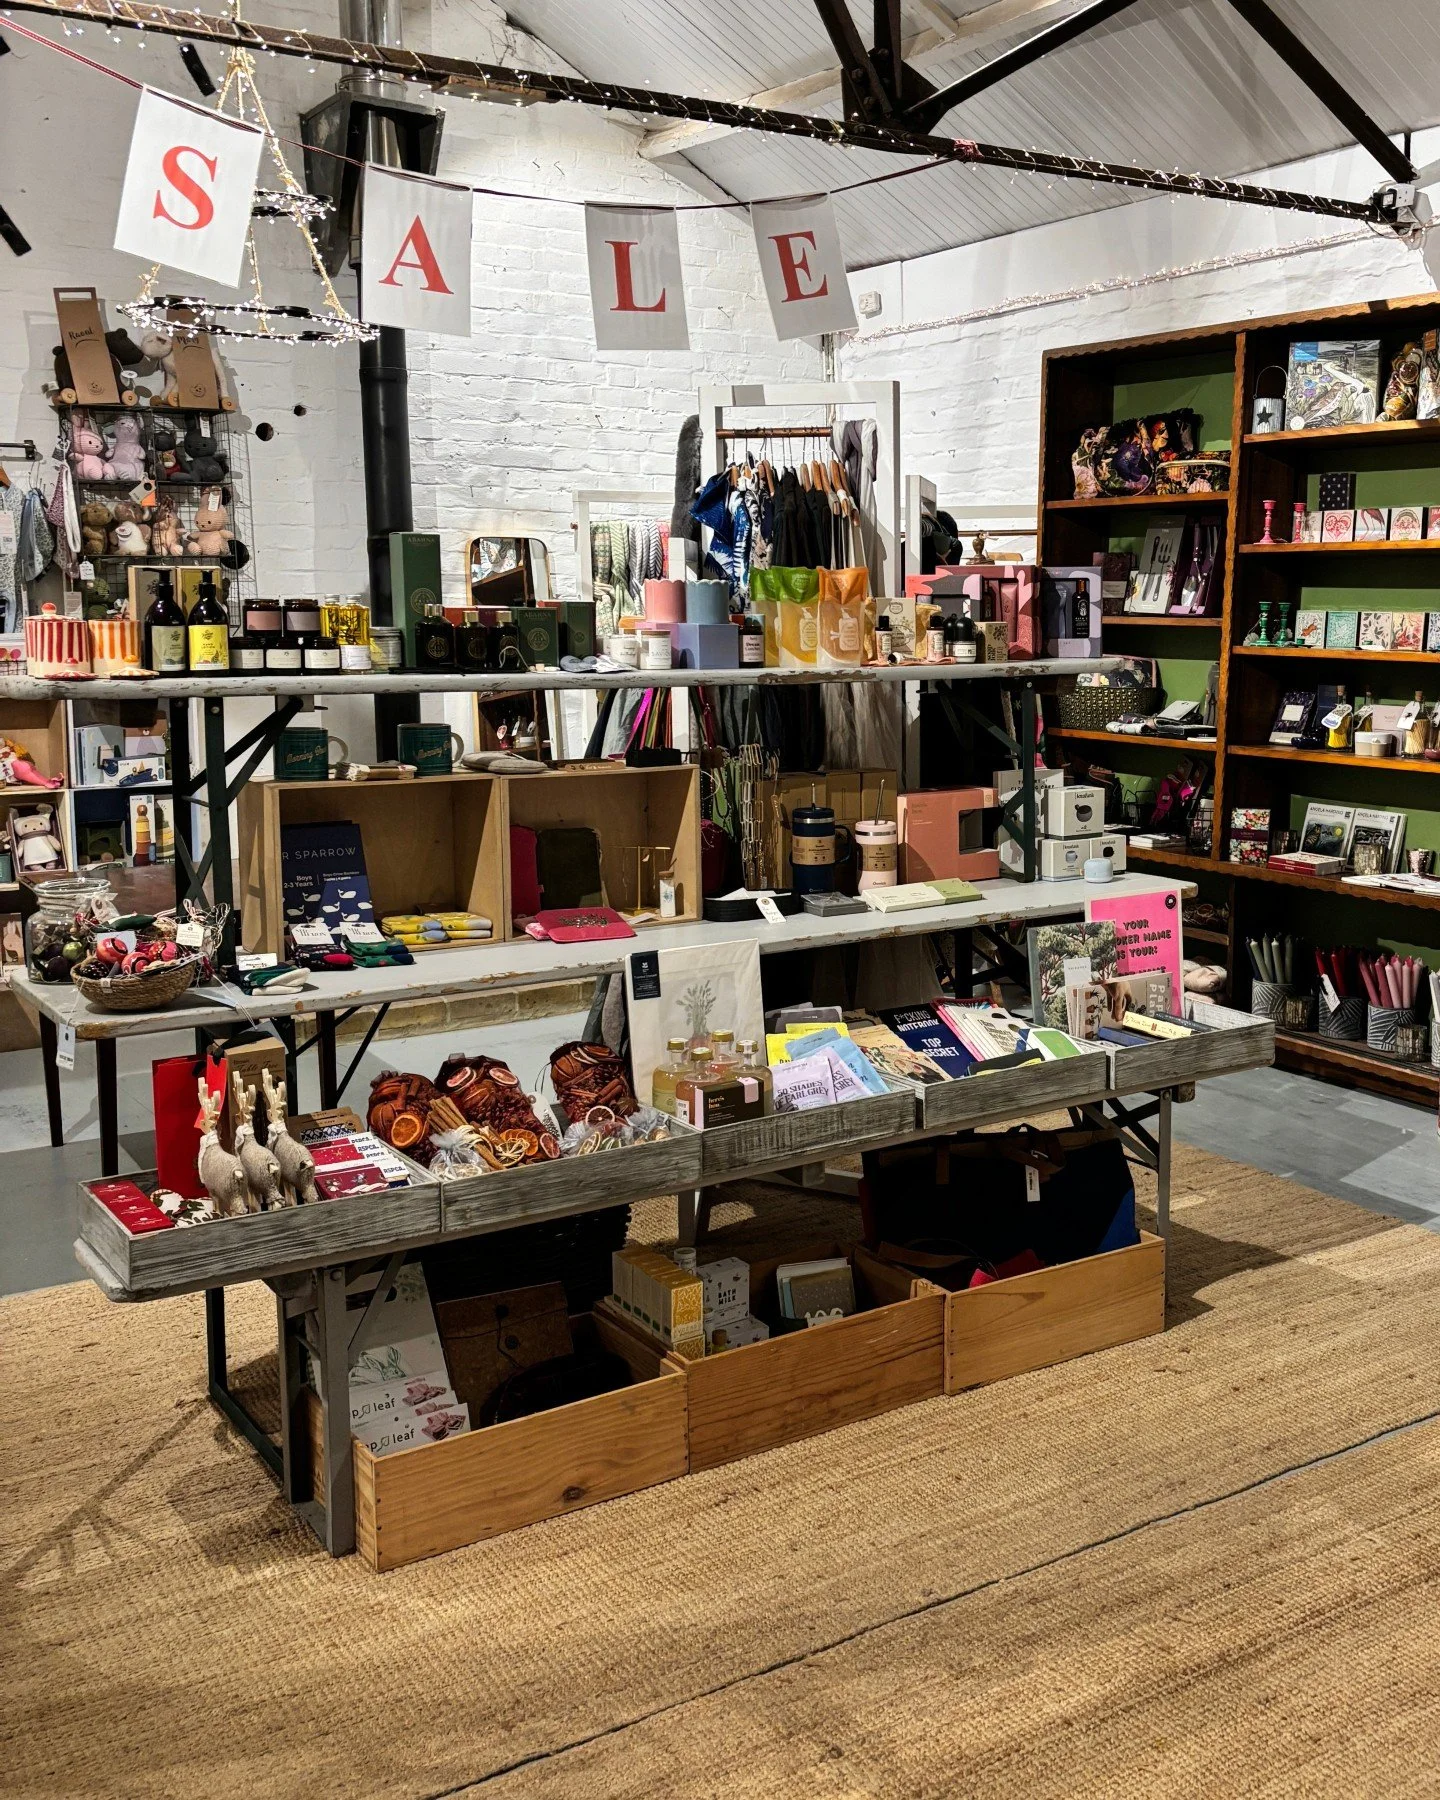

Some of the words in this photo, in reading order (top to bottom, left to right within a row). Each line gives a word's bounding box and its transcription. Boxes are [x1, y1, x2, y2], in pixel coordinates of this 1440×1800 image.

[294, 847, 356, 860] SPARROW
[295, 880, 314, 888] Years
[1123, 919, 1149, 931] YOUR
[1115, 934, 1140, 946] OKER
[1143, 929, 1172, 942] NAME
[921, 1037, 942, 1048] TOP
[922, 1046, 960, 1058] SECRET
[790, 1080, 823, 1092] SHADES
[785, 1090, 808, 1103] EARL
[808, 1087, 829, 1097] GREY
[717, 1288, 737, 1299] BATH
[718, 1296, 736, 1306] MILK
[373, 1398, 395, 1412] leaf
[392, 1428, 415, 1444] leaf
